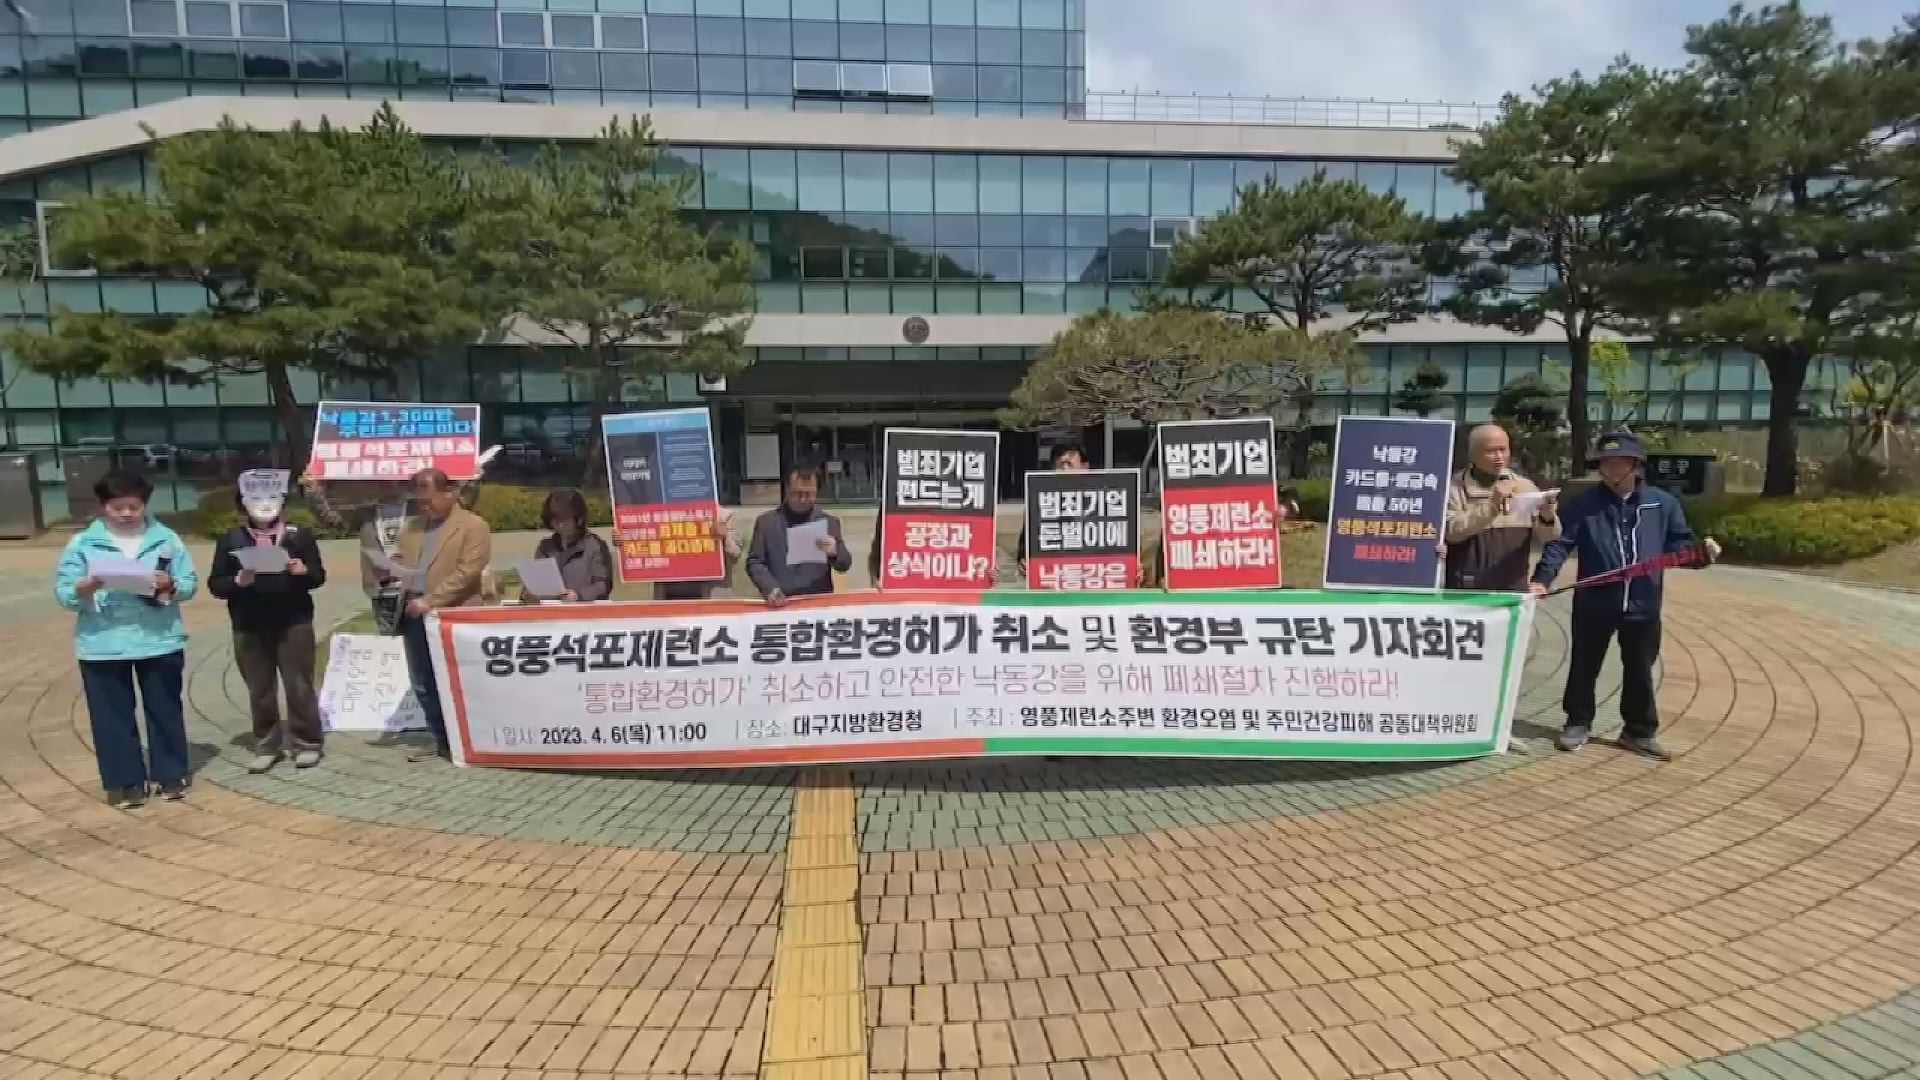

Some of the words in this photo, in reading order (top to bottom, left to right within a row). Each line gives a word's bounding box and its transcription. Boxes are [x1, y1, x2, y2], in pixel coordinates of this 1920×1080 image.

[897, 449, 986, 480] 범죄기업
[1164, 438, 1270, 480] 범죄기업
[1373, 445, 1417, 464] 낙동강
[1038, 488, 1127, 519] 범죄기업
[1167, 500, 1274, 535] 영풍제련소
[905, 521, 973, 549] 공정과
[1038, 520, 1128, 551] 돈벌이에
[1169, 537, 1275, 571] 폐쇄하라!
[1038, 563, 1128, 589] 낙동강은
[481, 625, 739, 677] 영풍석포제련소
[750, 613, 982, 664] 통합환경허가
[992, 613, 1070, 654] 취소
[1081, 614, 1118, 652] 및
[1128, 613, 1248, 655] 환경부
[1255, 617, 1335, 656] 규탄
[1343, 616, 1485, 660] 기자회견
[761, 668, 871, 704] 취소하고
[879, 665, 965, 697] 안전한
[973, 664, 1086, 696] 낙동강을
[1097, 663, 1153, 695] 위해
[1161, 664, 1277, 697] 폐쇄절차
[1285, 666, 1399, 699] 진행하라!
[540, 727, 588, 745] 2023.
[591, 725, 607, 744] 4.
[611, 723, 651, 745] 6(목)
[656, 722, 707, 743] 11:00
[793, 708, 922, 736] 대구지방환경청
[1020, 706, 1155, 728] 영풍제련소주변
[1161, 706, 1236, 731] 환경오염
[1242, 708, 1261, 731] 및
[1266, 709, 1374, 733] 주민건강피해
[1379, 713, 1478, 735] 공동대책위원회
